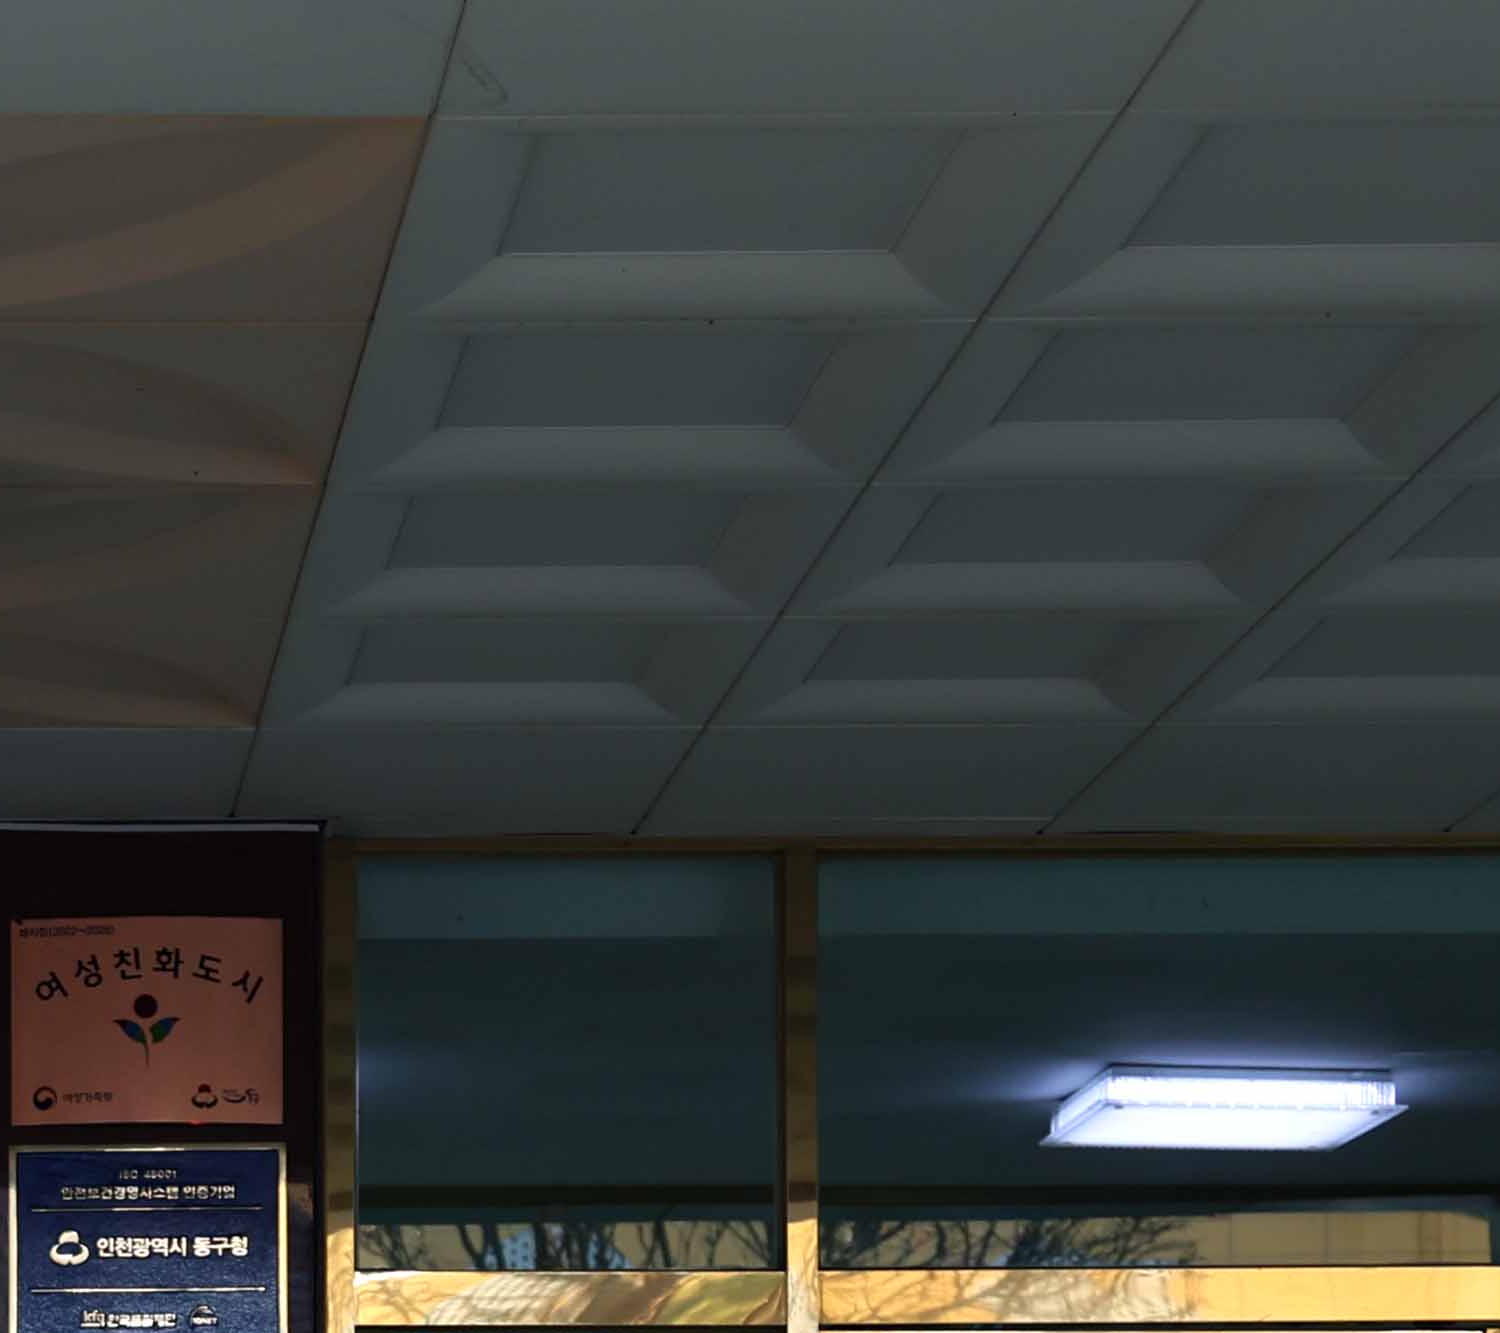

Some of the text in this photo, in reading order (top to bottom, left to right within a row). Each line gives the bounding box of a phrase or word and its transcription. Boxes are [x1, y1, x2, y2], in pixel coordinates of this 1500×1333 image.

[35, 947, 264, 1003] 여성친화도시
[96, 1235, 249, 1257] 인천광역시 동구청
